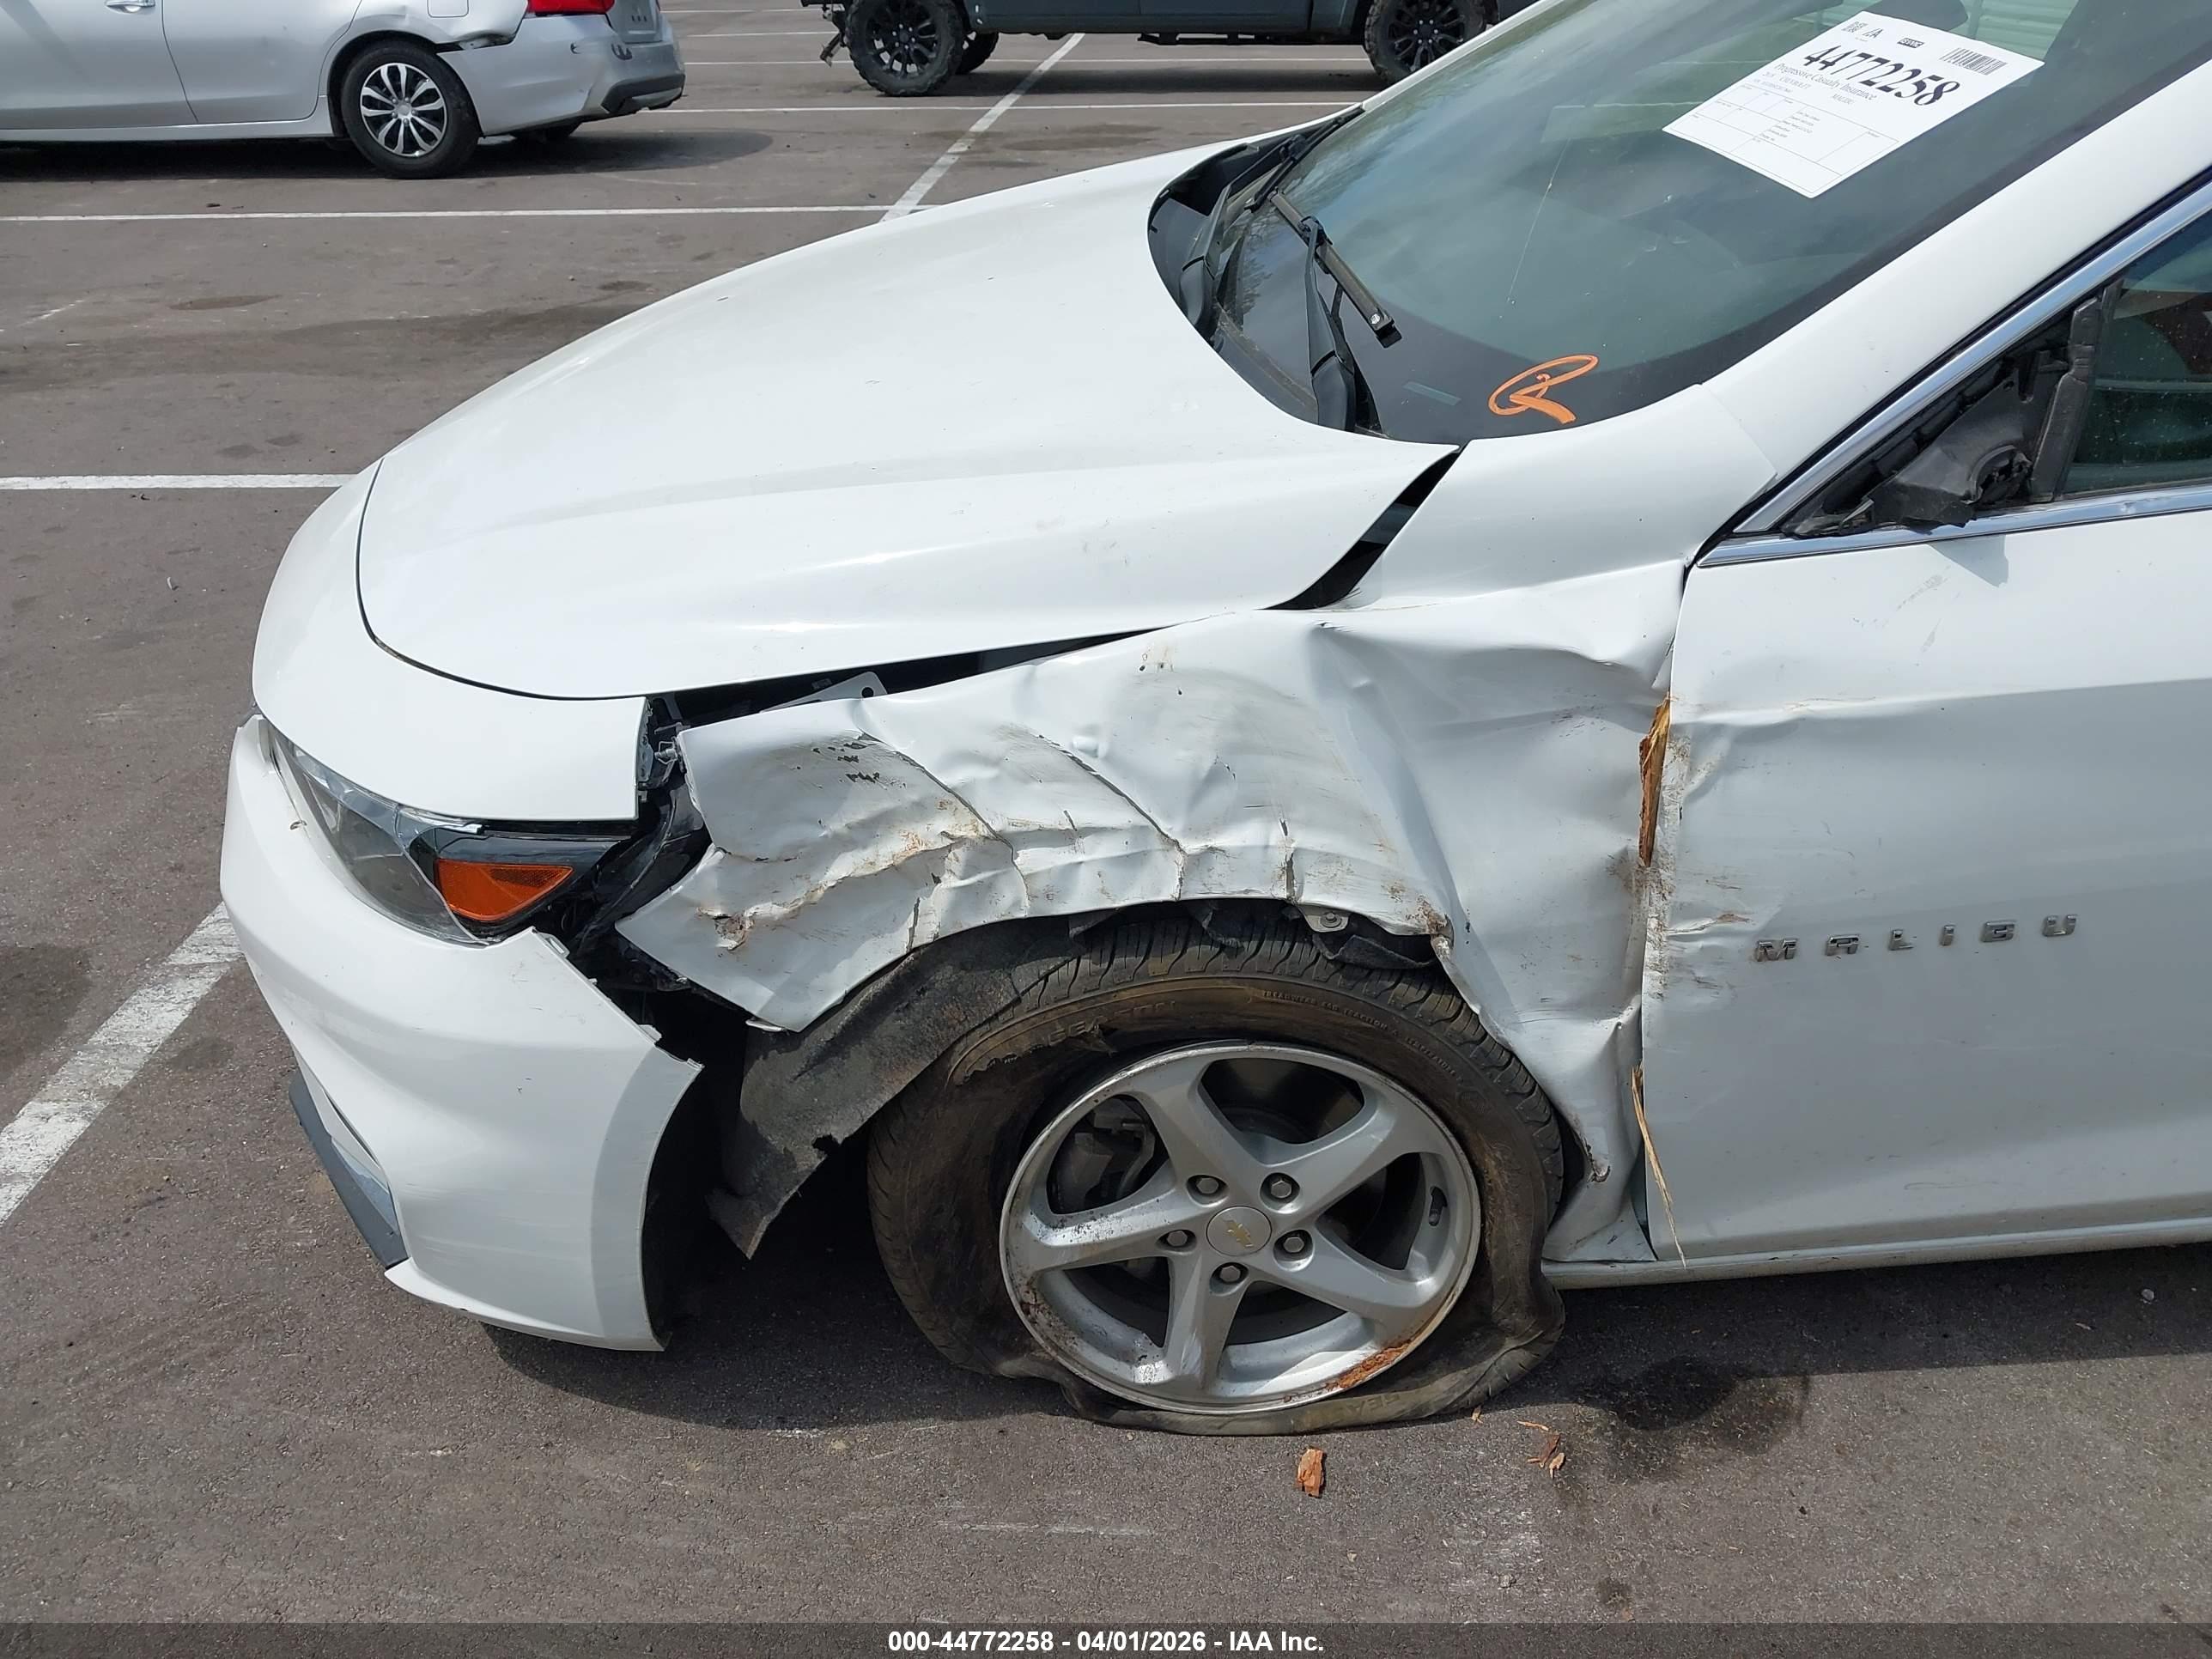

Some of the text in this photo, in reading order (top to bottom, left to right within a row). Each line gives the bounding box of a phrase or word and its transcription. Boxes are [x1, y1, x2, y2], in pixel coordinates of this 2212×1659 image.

[1773, 63, 1814, 80] Progressive
[1838, 83, 1878, 100] Insurance
[1803, 45, 1961, 106] 44772258
[1755, 914, 2078, 962] MALIBU
